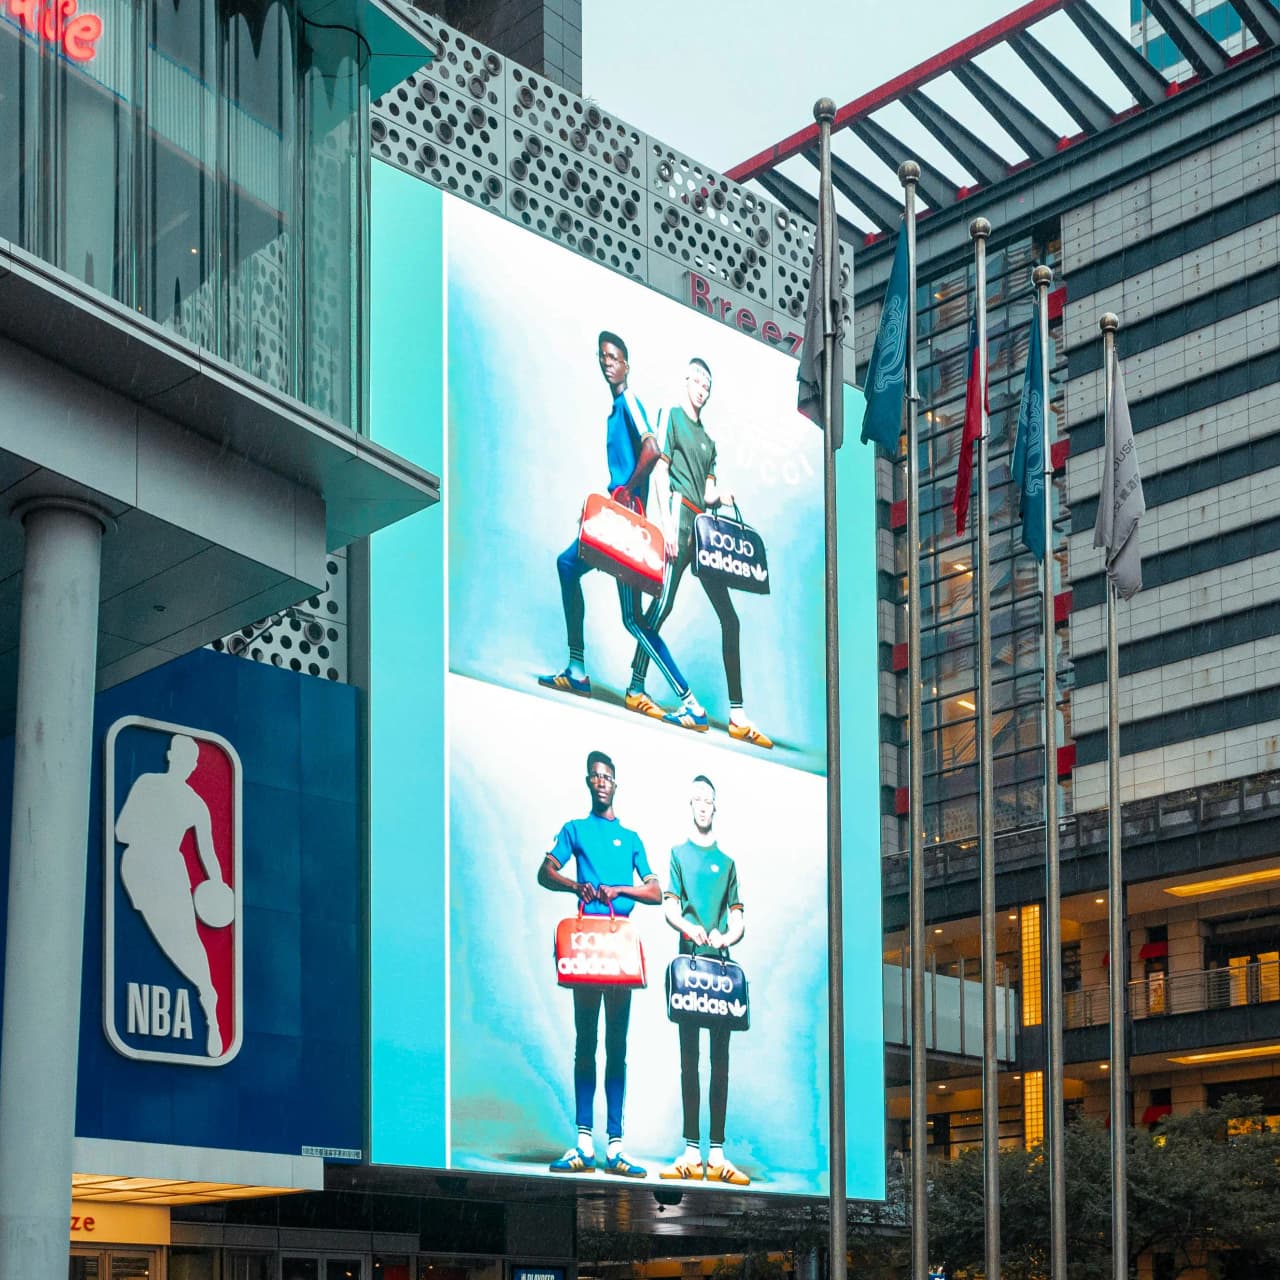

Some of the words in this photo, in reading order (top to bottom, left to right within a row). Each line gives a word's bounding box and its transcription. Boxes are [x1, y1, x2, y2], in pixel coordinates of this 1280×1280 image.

[686, 271, 804, 354] Breez
[699, 549, 751, 578] adidas
[127, 982, 194, 1040] NBA
[671, 991, 728, 1016] adidas
